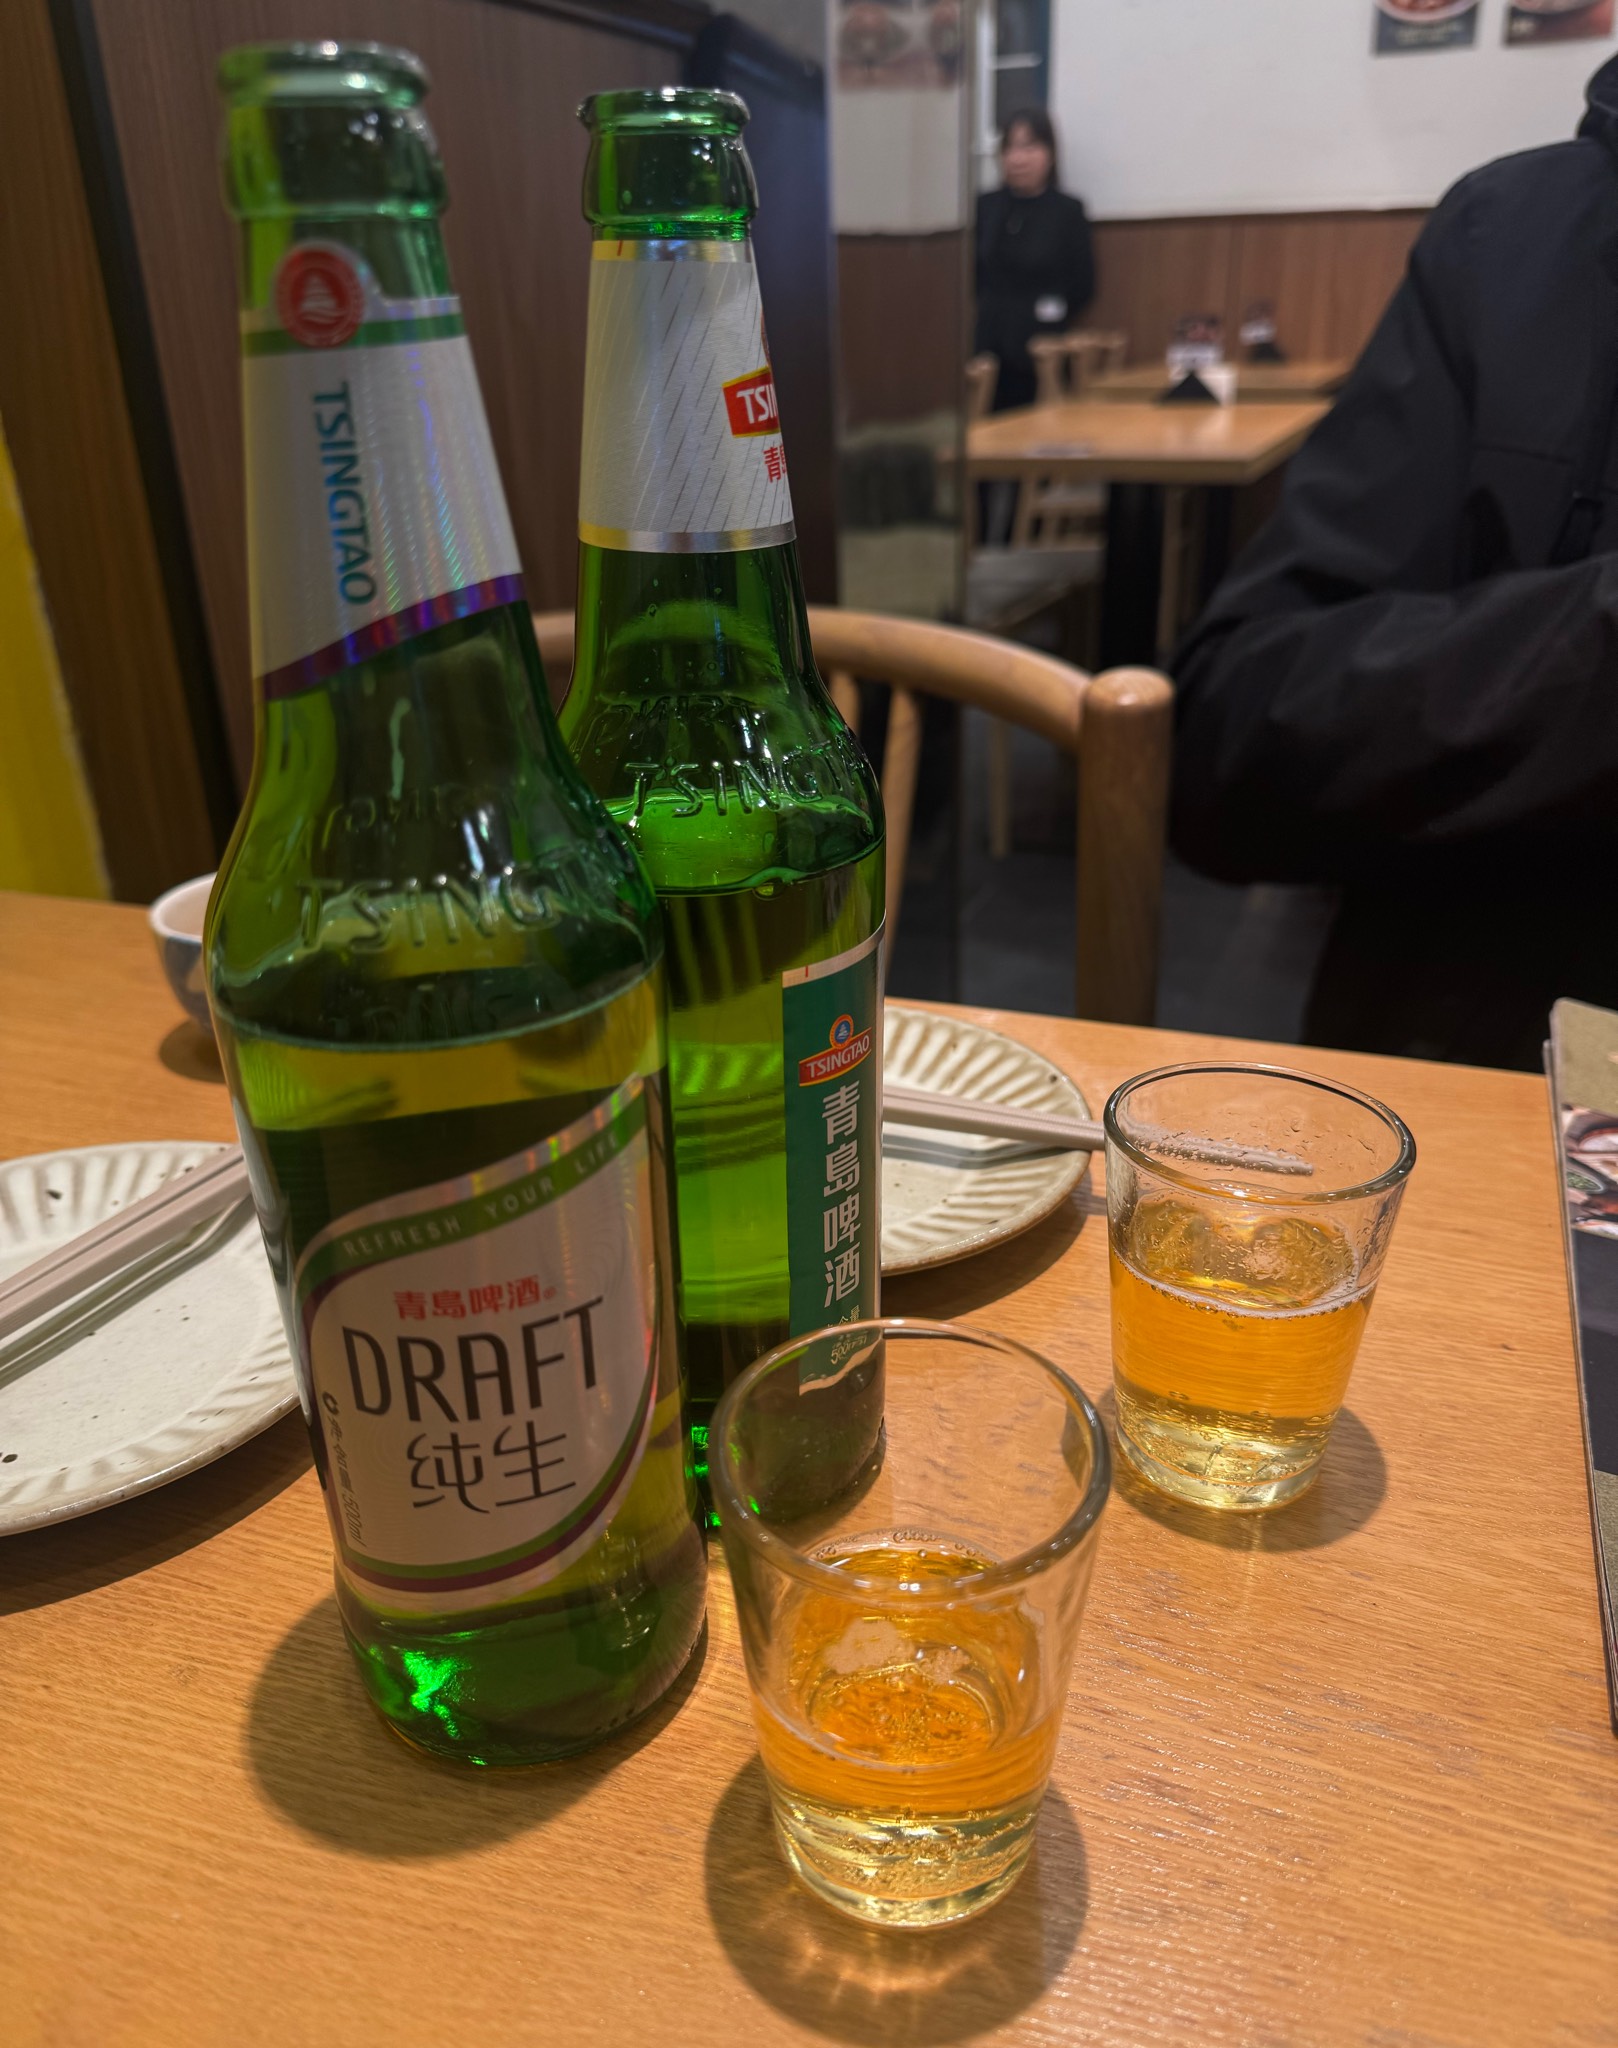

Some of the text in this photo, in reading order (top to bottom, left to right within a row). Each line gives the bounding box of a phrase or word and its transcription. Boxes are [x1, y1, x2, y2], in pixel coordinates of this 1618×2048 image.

[311, 381, 378, 607] TSINGTAO
[807, 1034, 869, 1078] TSINGTAO
[343, 1215, 461, 1258] REFRESH
[484, 1175, 555, 1218] YOUR
[822, 1080, 862, 1308] 青島啤酒
[342, 1296, 604, 1423] DRAFT
[406, 1420, 576, 1514] 纯生
